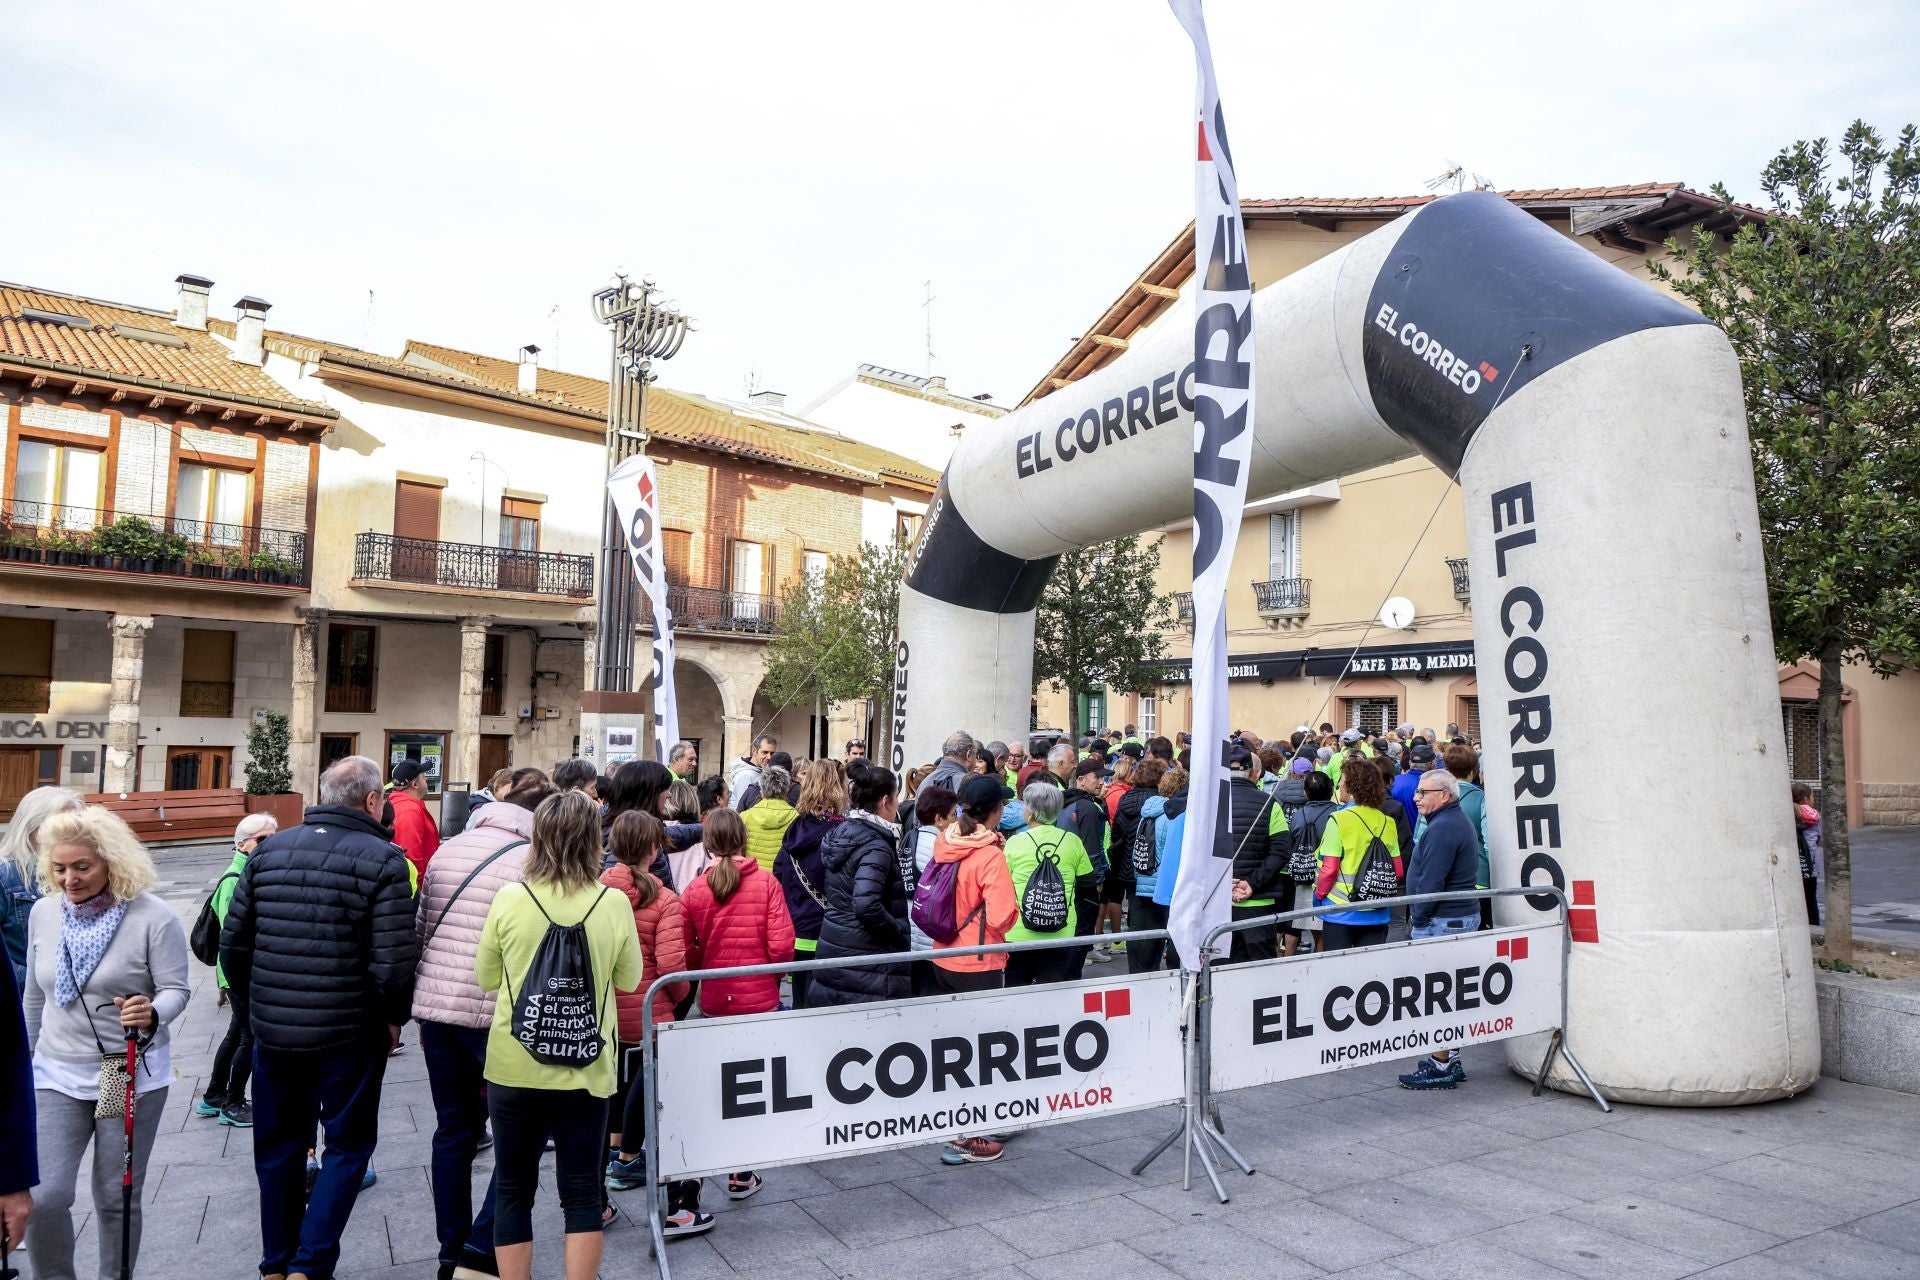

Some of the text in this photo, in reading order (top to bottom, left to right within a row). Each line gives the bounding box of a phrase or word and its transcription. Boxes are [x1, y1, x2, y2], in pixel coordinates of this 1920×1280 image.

[1375, 303, 1481, 395] EL CORREO
[1016, 431, 1053, 480] EL
[908, 498, 944, 578] EL CORREO
[1391, 657, 1422, 671] BAR
[1491, 481, 1566, 912] EL CORREO
[519, 993, 544, 1052] ARABA
[541, 1013, 596, 1030] martxn
[543, 1002, 558, 1015] el
[1253, 962, 1513, 1046] EL CORREO
[536, 1041, 598, 1059] aurka
[721, 1019, 1109, 1120] EL CORREO
[1320, 1017, 1514, 1065] INFORMACIÓN CON VALOR
[825, 1086, 1113, 1146] INFORMACIÓN CON VALOR
